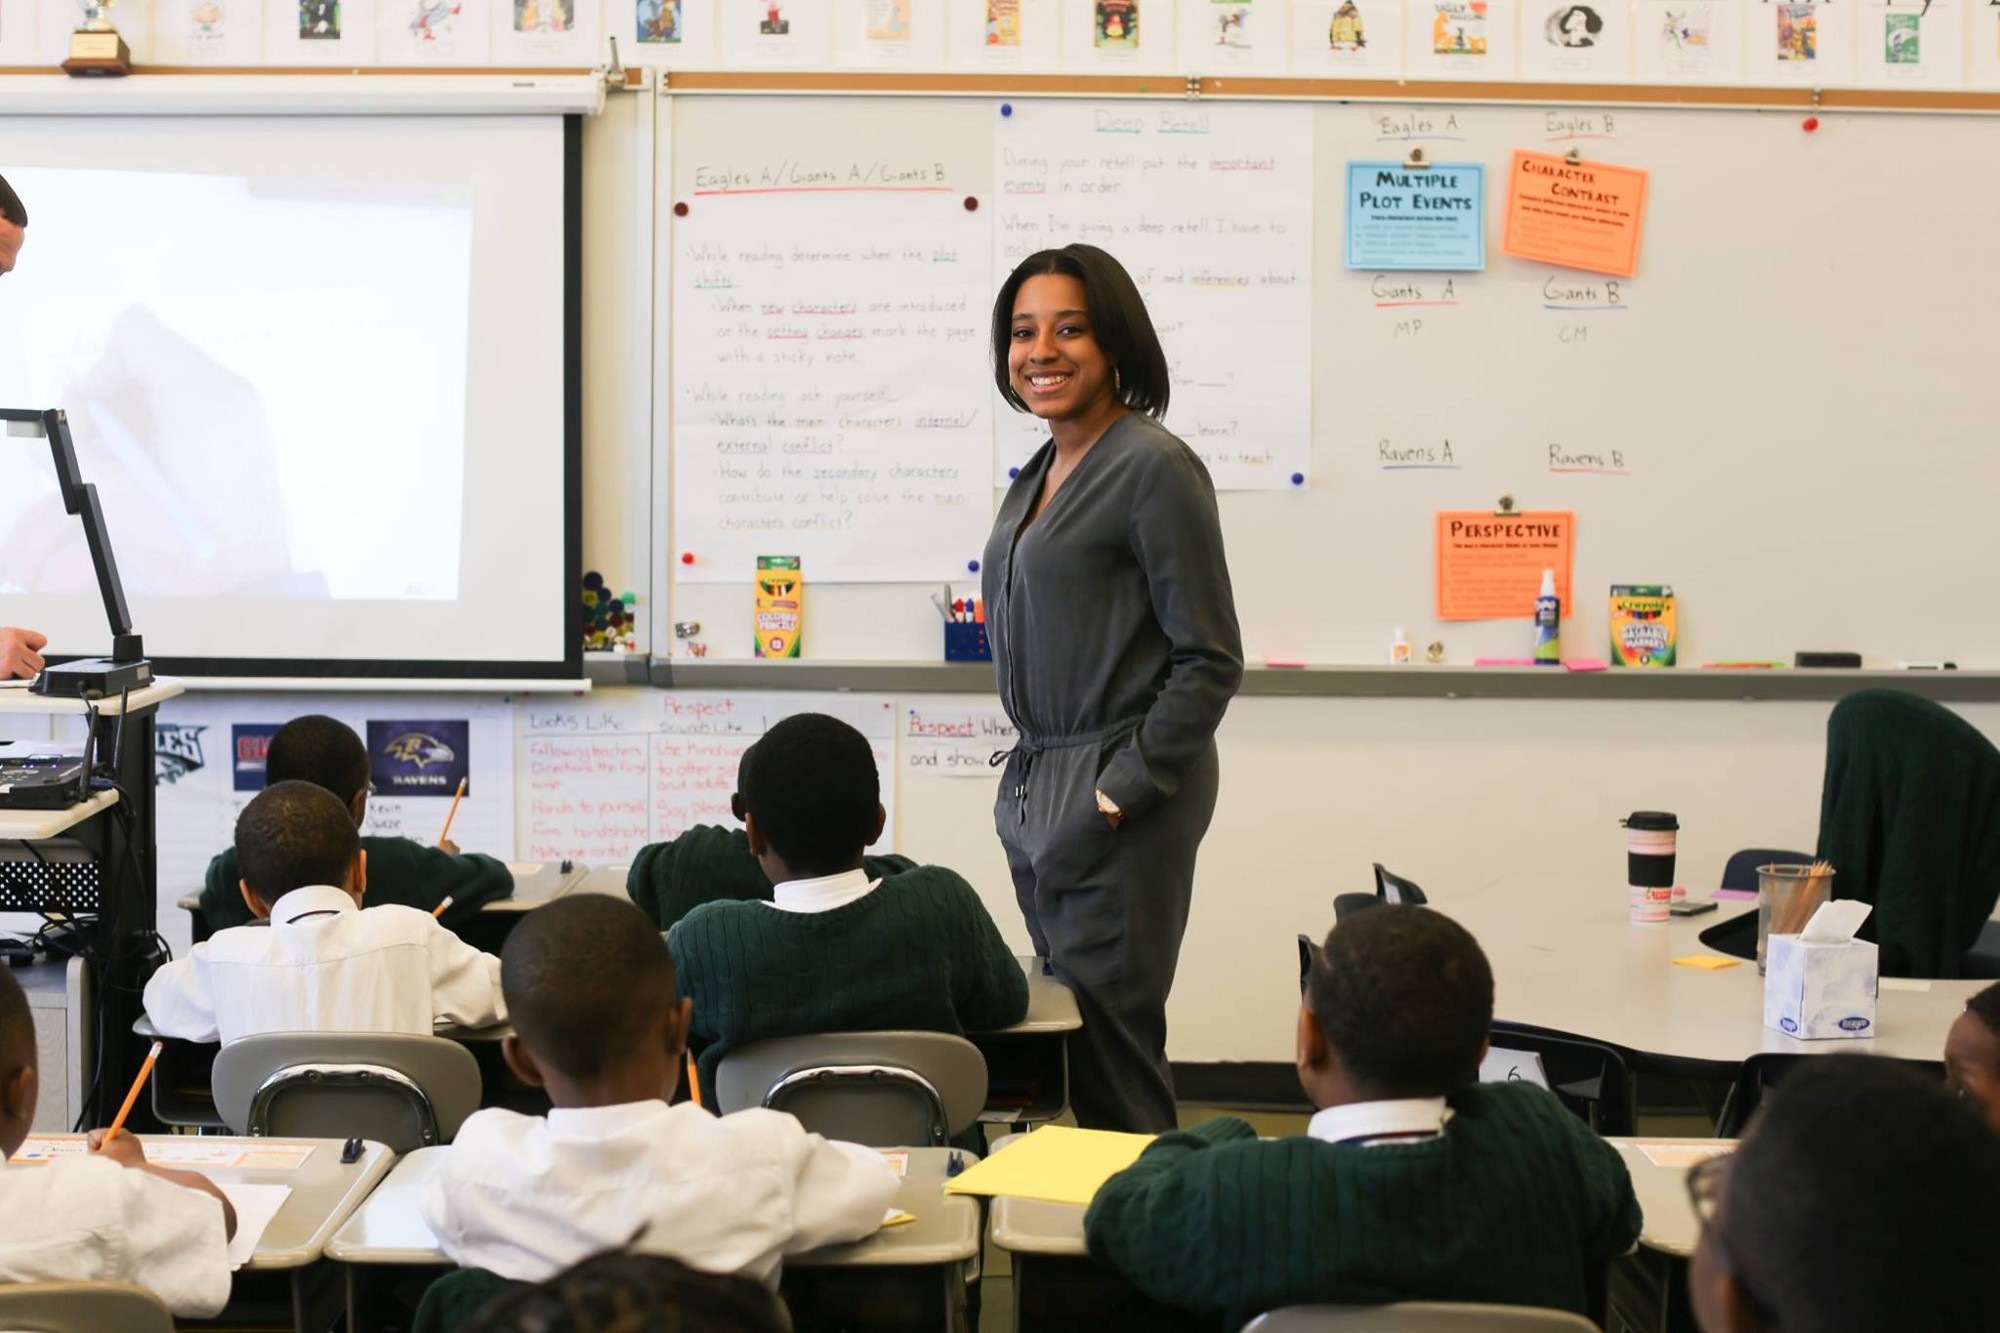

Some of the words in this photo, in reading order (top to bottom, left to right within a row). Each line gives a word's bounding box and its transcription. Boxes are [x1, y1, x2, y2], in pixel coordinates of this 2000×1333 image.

[1095, 109, 1144, 131] Deep
[1160, 110, 1210, 130] Retell
[1381, 114, 1433, 138] Eagles
[1446, 113, 1458, 129] A
[1546, 112, 1592, 138] Eagles
[1603, 114, 1615, 132] B
[1003, 148, 1047, 174] During
[1060, 158, 1087, 175] your
[1100, 152, 1134, 168] retell
[1143, 156, 1163, 175] put
[1178, 153, 1198, 169] the
[1209, 154, 1275, 172] important
[695, 165, 749, 190] Eagles
[935, 162, 946, 182] B
[1376, 171, 1458, 188] MULTIPLE
[1522, 160, 1595, 184] CHARACTER
[1004, 179, 1045, 194] events
[1060, 179, 1072, 192] in
[1551, 183, 1619, 206] CONTRAST
[1360, 192, 1402, 209] PLOT
[1412, 194, 1472, 210] EVENTS
[1002, 214, 1038, 232] When
[1137, 216, 1164, 234] deep
[1217, 218, 1224, 233] I
[1232, 219, 1261, 233] have
[1270, 219, 1286, 233] to
[692, 244, 728, 262] While
[739, 243, 784, 268] reading
[791, 245, 851, 262] determine
[860, 246, 892, 262] when
[902, 245, 923, 262] the
[933, 244, 957, 262] plot
[1164, 267, 1184, 283] and
[1191, 267, 1250, 286] inferences
[1260, 266, 1296, 284] about
[1371, 275, 1422, 299] Giants
[1441, 278, 1454, 299] A
[1543, 276, 1596, 300] Giants
[1606, 281, 1621, 304] B
[717, 297, 752, 313] When
[761, 303, 784, 314] new
[792, 299, 857, 314] characters
[868, 303, 891, 313] are
[899, 294, 967, 313] introduced
[717, 327, 731, 338] or
[738, 322, 758, 338] the
[767, 324, 808, 345] setting
[816, 325, 863, 344] changes
[872, 321, 905, 337] mark
[917, 321, 936, 337] the
[947, 326, 975, 344] page
[1394, 319, 1422, 338] MP
[1559, 326, 1588, 343] CM
[717, 348, 748, 363] with
[755, 353, 764, 363] a
[774, 347, 814, 366] sticky
[692, 383, 728, 402] While
[739, 385, 785, 408] reading
[800, 386, 820, 402] ask
[767, 412, 785, 428] the
[796, 414, 824, 428] main
[717, 436, 772, 452] external
[782, 434, 845, 453] conflict?
[1379, 440, 1434, 462] Ravens
[1441, 439, 1453, 462] A
[1239, 448, 1273, 464] teach
[1549, 444, 1604, 467] Ravens
[1612, 450, 1624, 468] B
[720, 461, 746, 479] How
[756, 460, 771, 478] do
[782, 462, 802, 478] the
[813, 461, 878, 481] secondary
[889, 462, 960, 479] characters
[719, 489, 784, 505] contribute
[796, 493, 809, 505] or
[821, 488, 847, 507] help
[857, 488, 889, 504] solve
[902, 487, 924, 503] the
[934, 490, 966, 505] main
[792, 510, 853, 530] conflict?
[1451, 521, 1560, 538] PERSPECTIVE
[664, 695, 735, 721] Respect
[530, 711, 579, 730] Looks
[586, 712, 624, 731] Like
[660, 722, 711, 734] Sounds
[713, 721, 743, 734] Like
[531, 743, 591, 763] Following
[592, 743, 642, 757] teachers
[910, 749, 937, 767] and
[947, 748, 985, 767] show
[532, 760, 593, 775] Directions
[599, 760, 615, 773] the
[657, 761, 672, 776] to
[677, 760, 708, 777] other
[392, 775, 447, 785] RAVENS
[658, 778, 686, 791] and
[693, 778, 729, 791] adults
[532, 799, 573, 816] Hands
[580, 799, 594, 815] to
[599, 799, 645, 821] yourself
[657, 800, 688, 821] Say
[573, 822, 648, 838] handshake
[532, 844, 563, 859] Make
